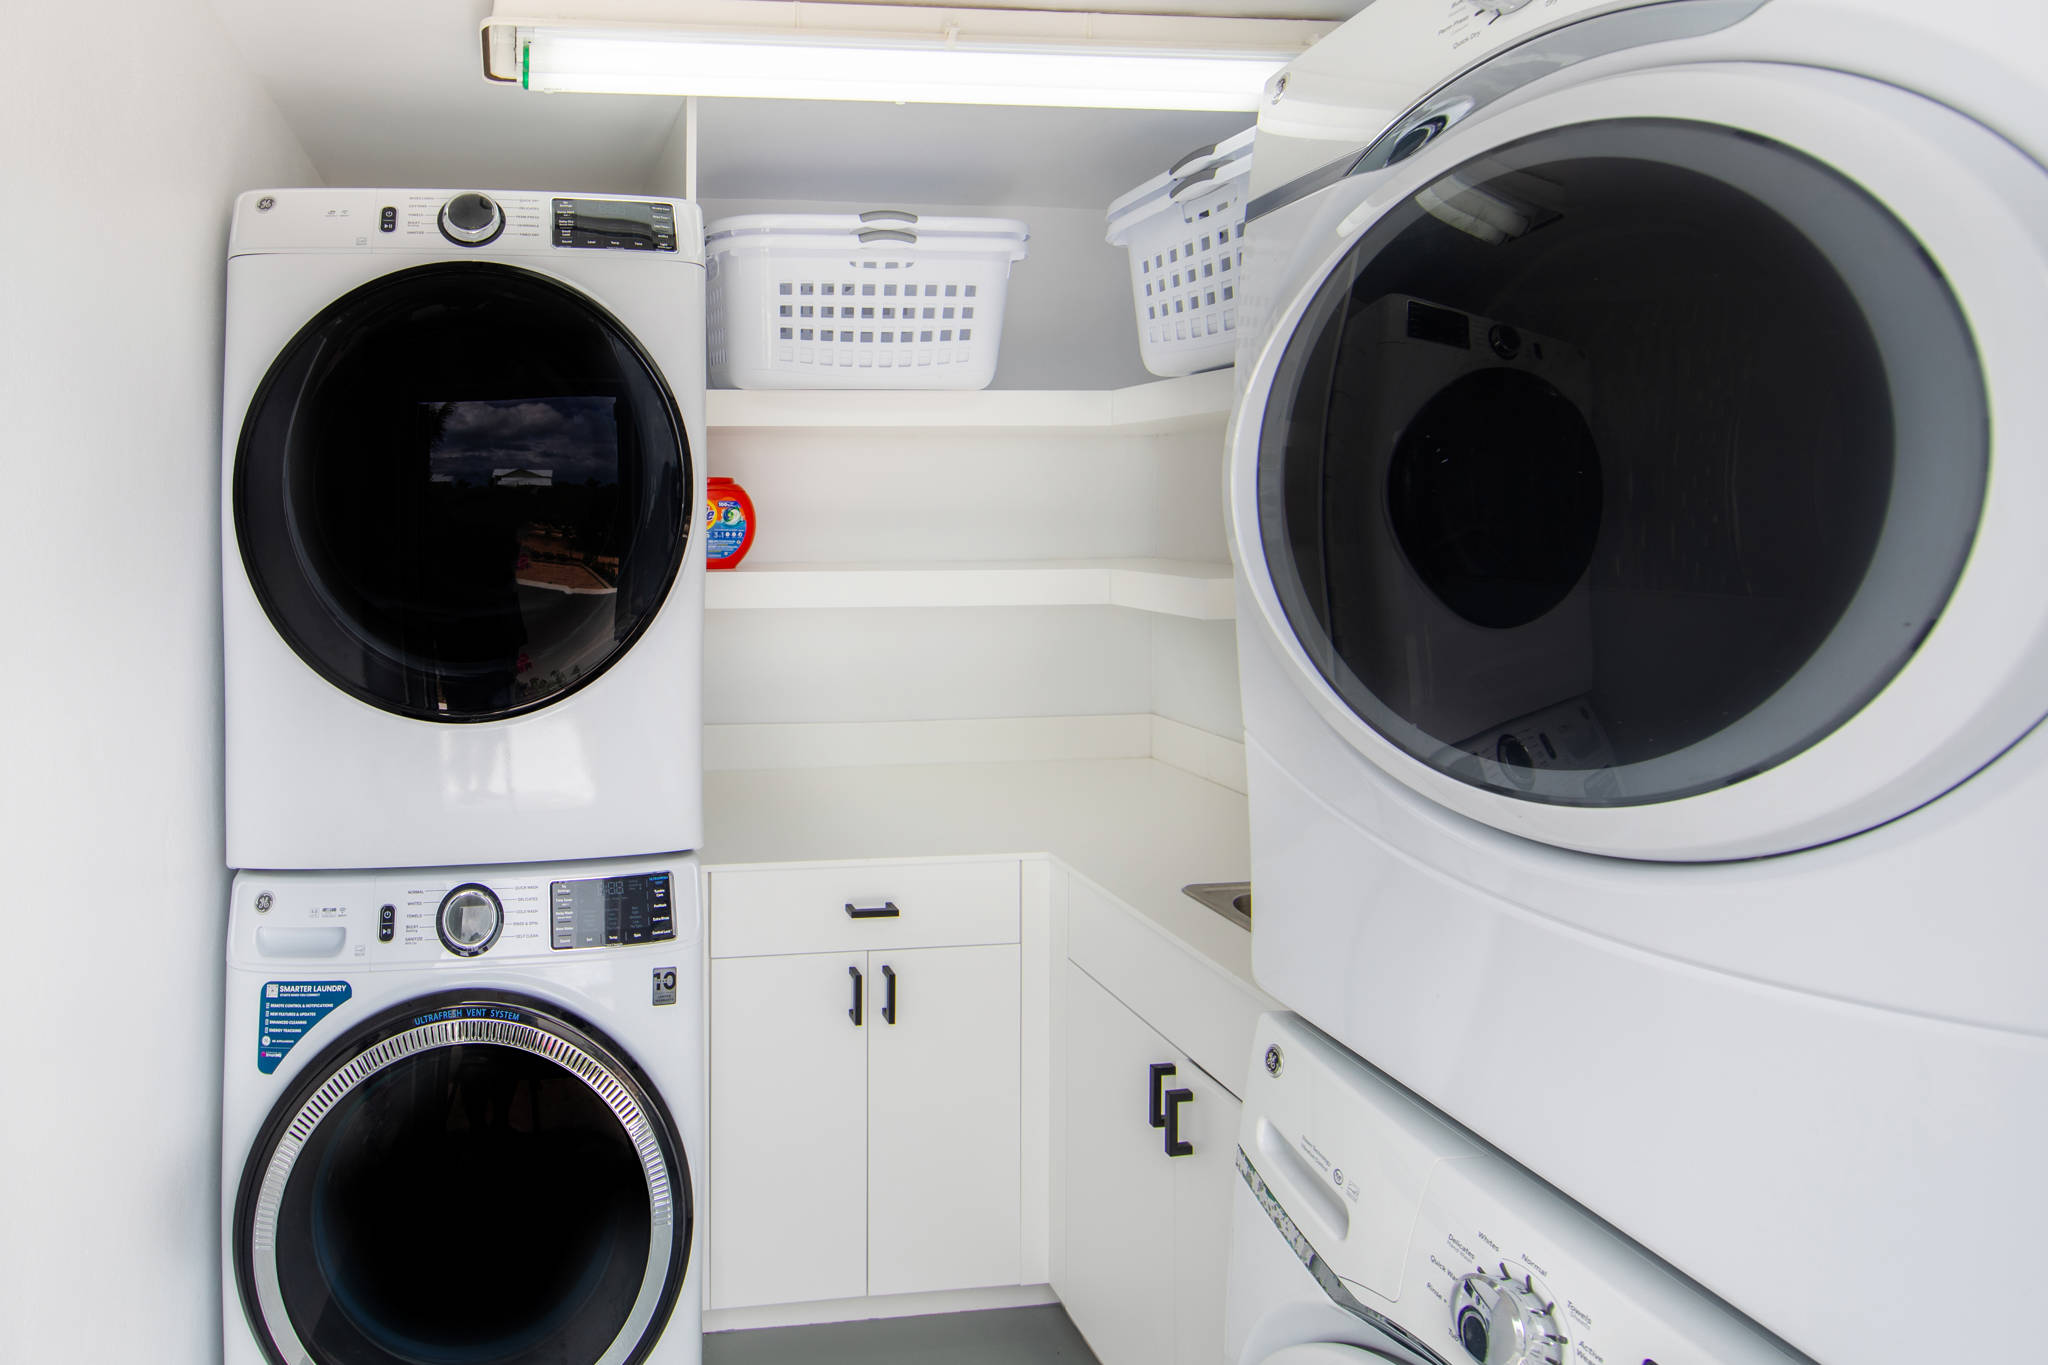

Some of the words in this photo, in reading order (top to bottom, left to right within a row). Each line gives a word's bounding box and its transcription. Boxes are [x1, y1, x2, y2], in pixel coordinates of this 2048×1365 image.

[279, 985, 312, 993] SMARTER
[313, 984, 347, 992] LAUNDRY
[414, 1009, 463, 1026] ULTRAFRESH
[466, 1008, 487, 1017] VENT
[490, 1009, 520, 1021] SYSTEM
[1448, 1233, 1475, 1260] Delicates
[1478, 1231, 1499, 1251] Whites
[1430, 1254, 1446, 1272] Quick
[1521, 1253, 1548, 1277] Normal
[1427, 1281, 1442, 1299] Rinse
[1567, 1300, 1592, 1325] Towels
[1579, 1340, 1604, 1362] Active
